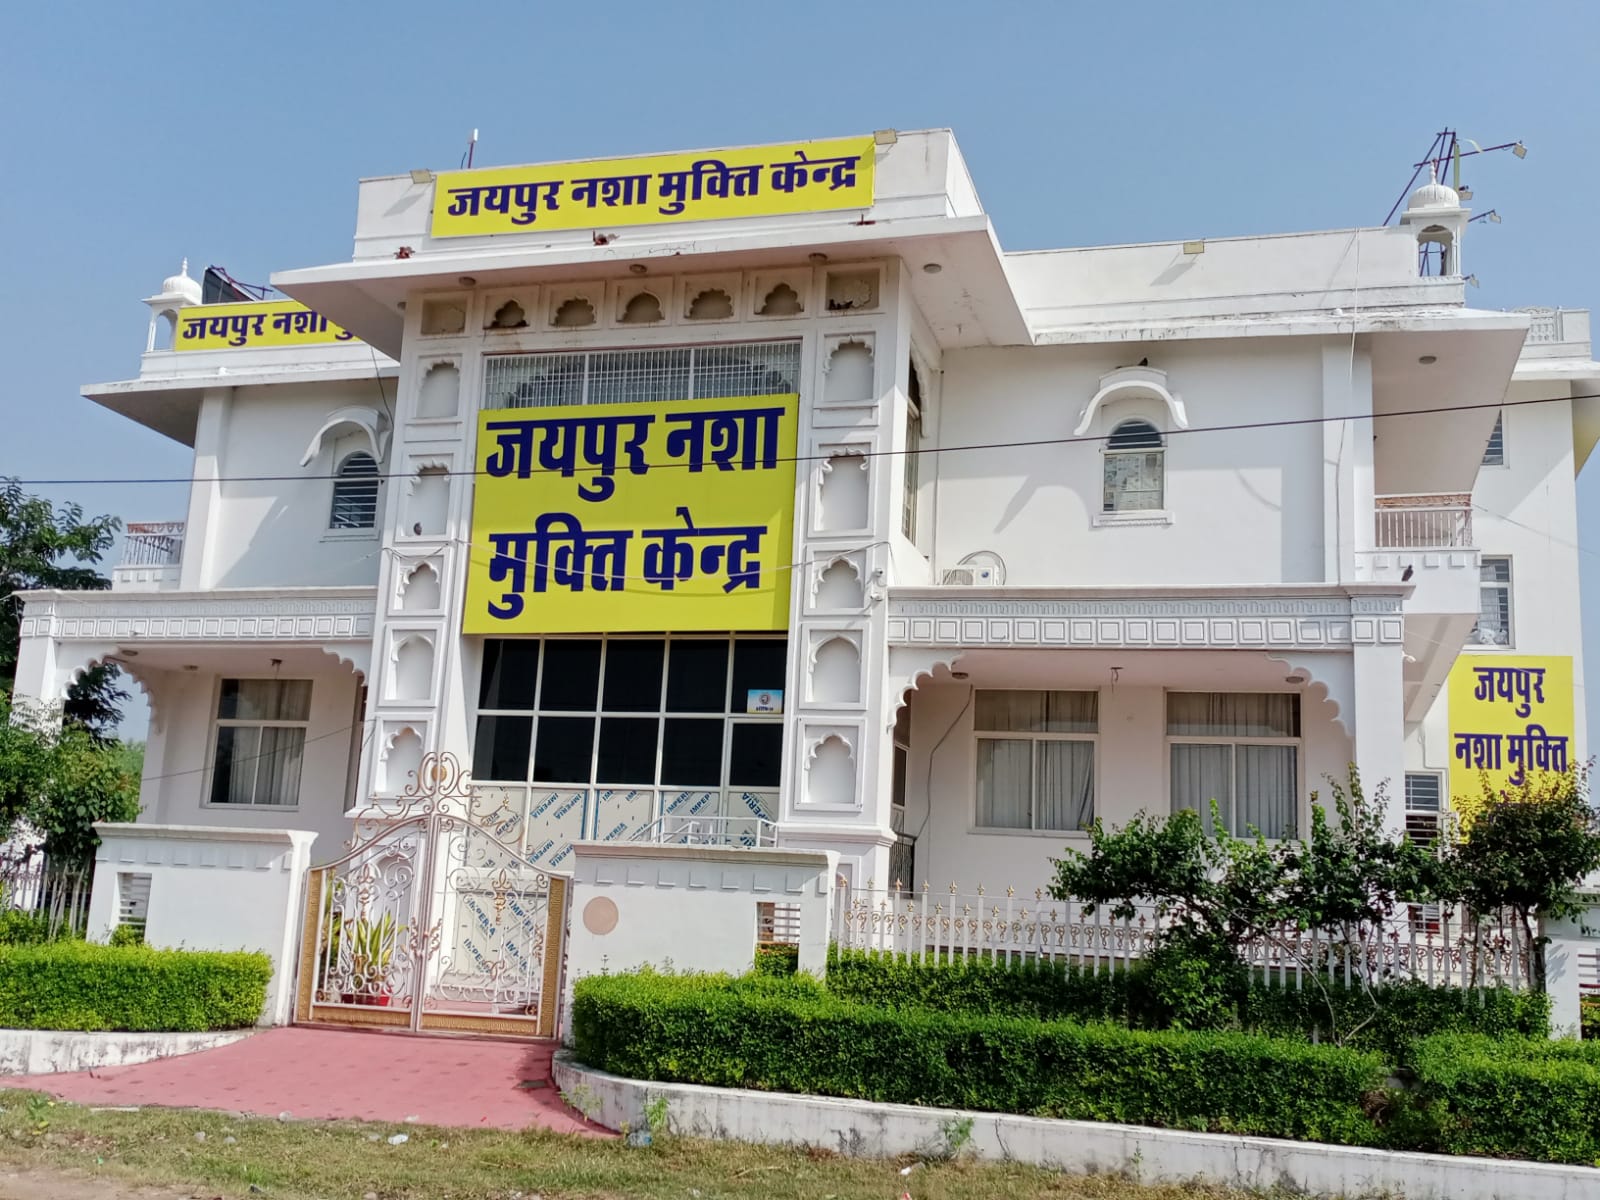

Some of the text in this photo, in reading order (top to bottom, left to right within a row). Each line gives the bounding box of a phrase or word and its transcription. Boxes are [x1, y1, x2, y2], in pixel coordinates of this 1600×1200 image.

[448, 151, 861, 225] जयपुर नशा मुक्ति केन्द्र
[183, 309, 327, 346] जयपुर नशा
[486, 407, 786, 502] जयपुर नशा
[488, 506, 768, 620] मुक्ति केन्द्र
[1473, 667, 1546, 718] जयपुर
[1454, 724, 1569, 786] नशा मुक्ति
[531, 793, 559, 818] IMPERIA
[555, 793, 582, 819] IMPERIA
[529, 840, 554, 864] IMPERI
